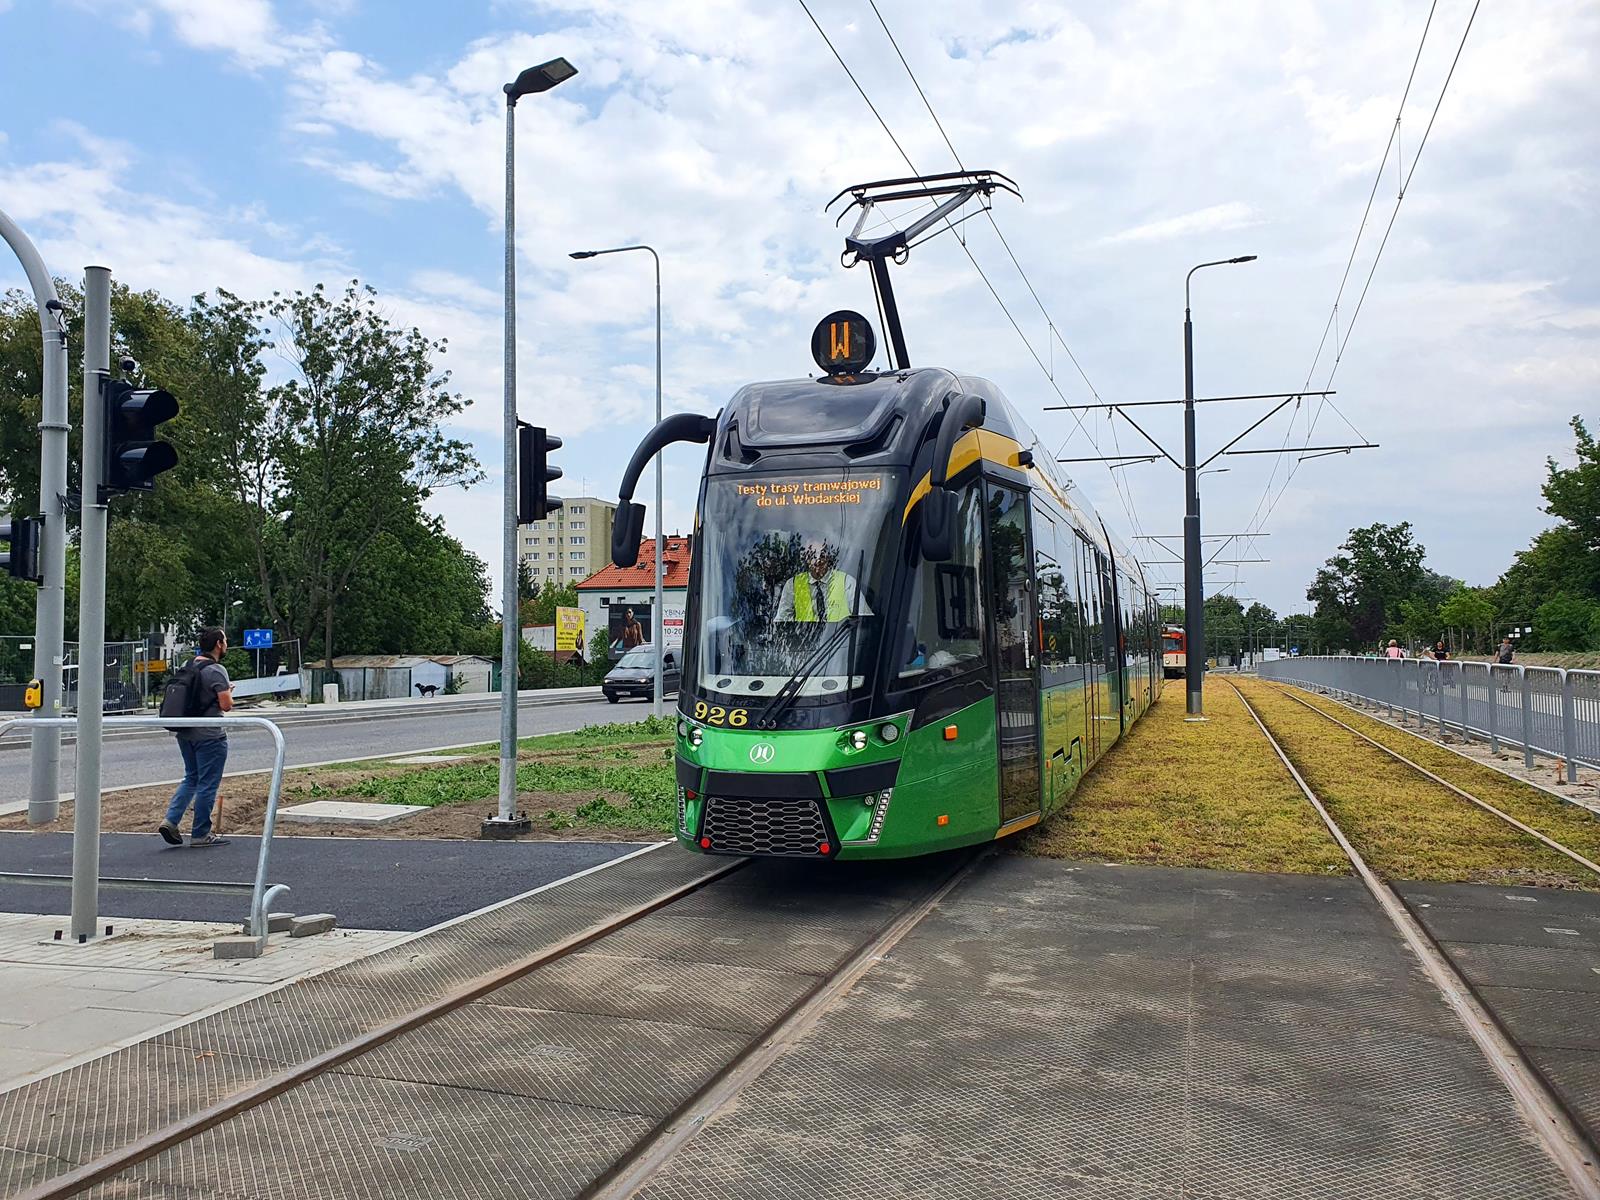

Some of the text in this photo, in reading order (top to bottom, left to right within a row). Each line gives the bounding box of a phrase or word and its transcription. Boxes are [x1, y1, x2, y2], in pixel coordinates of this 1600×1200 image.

[831, 321, 849, 360] W
[737, 478, 881, 496] Testy trasy tramwajowej
[757, 492, 861, 507] do ul. Włodarskiej
[695, 701, 748, 726] 926
